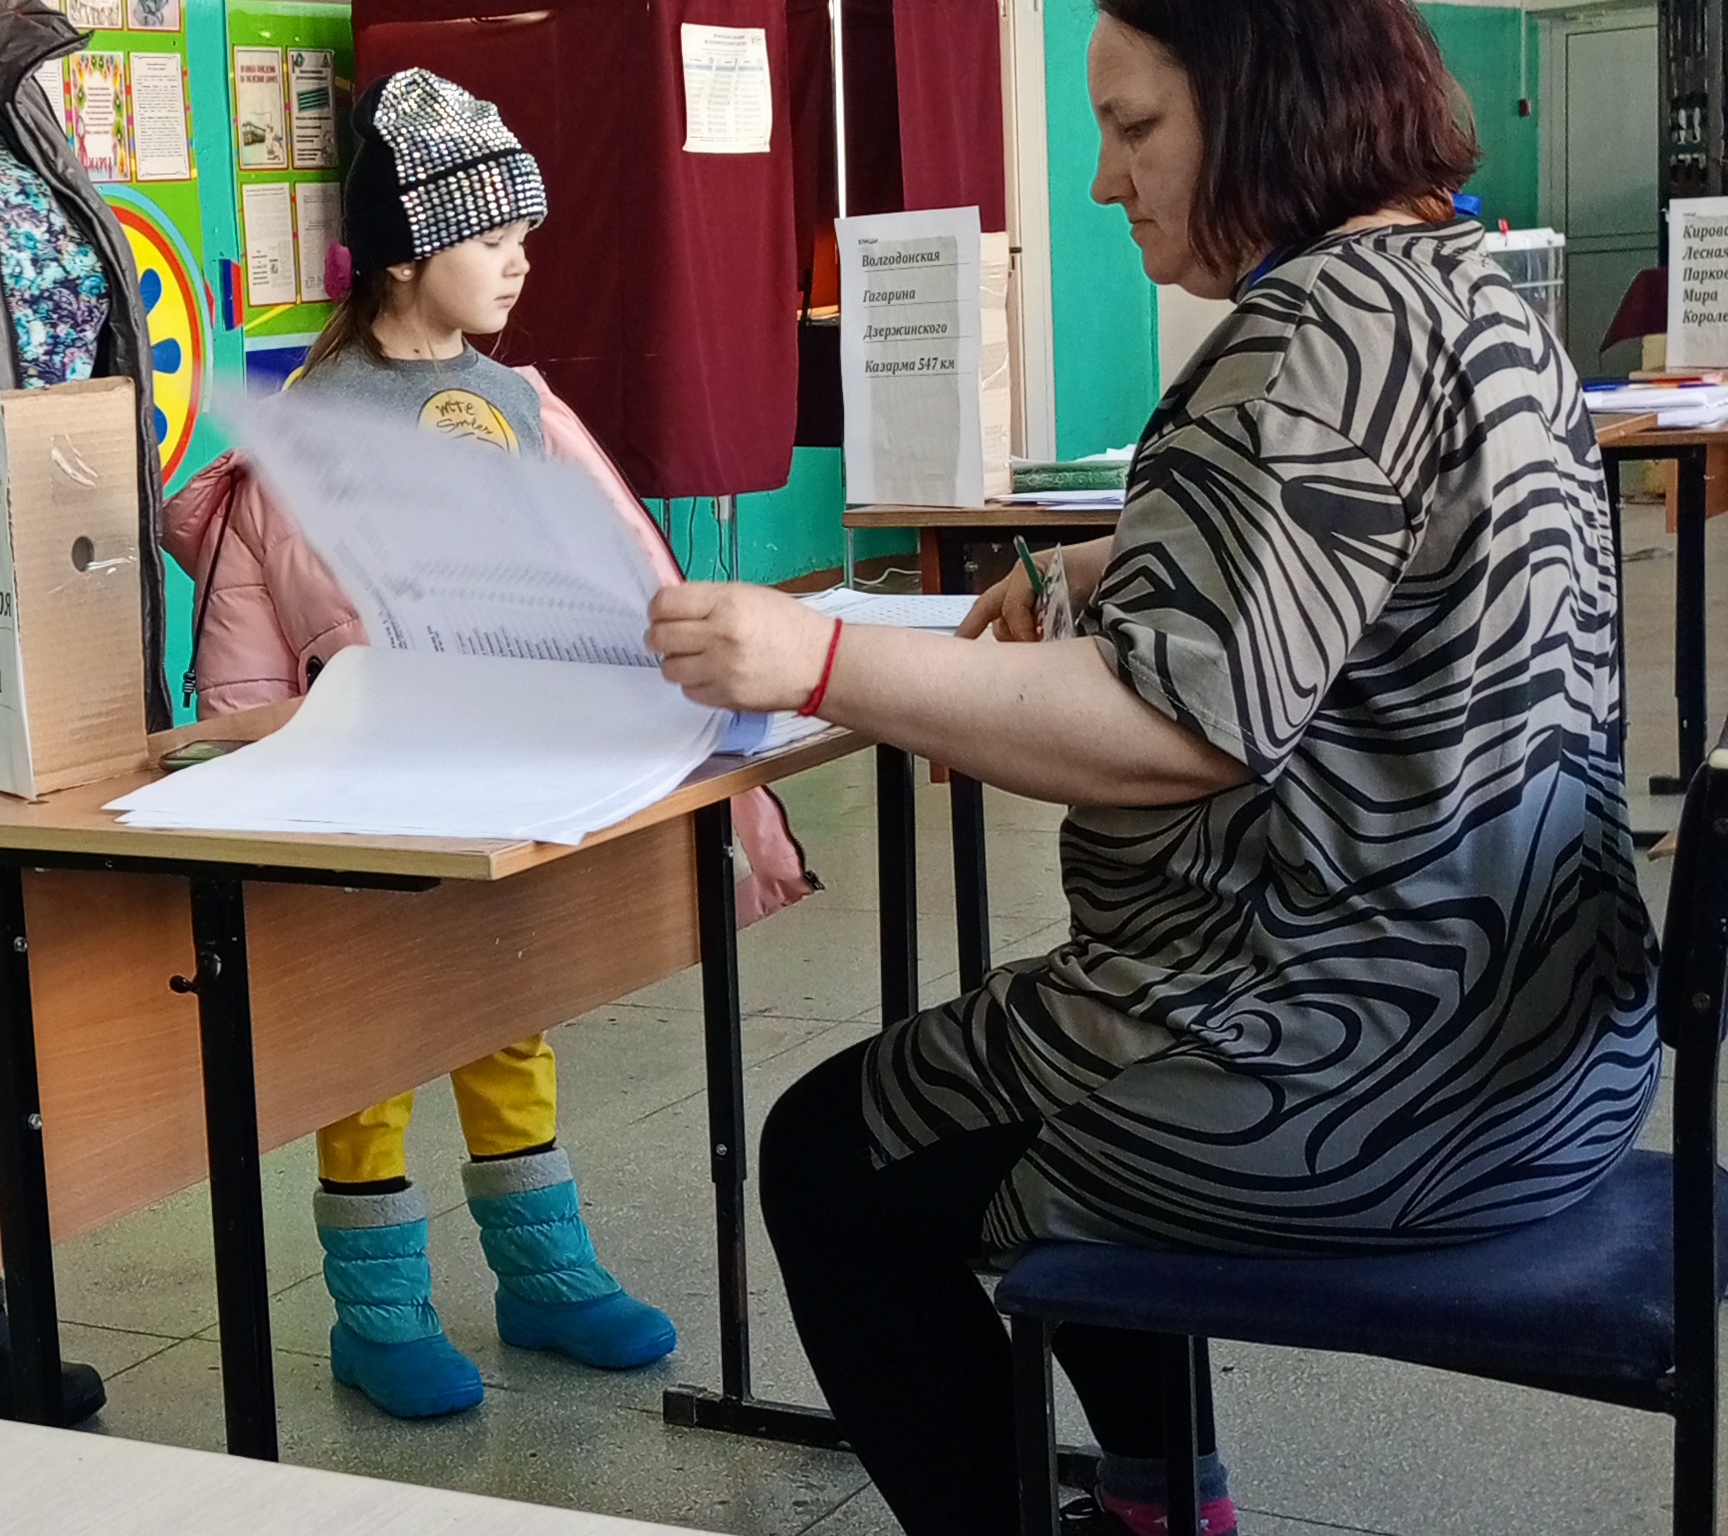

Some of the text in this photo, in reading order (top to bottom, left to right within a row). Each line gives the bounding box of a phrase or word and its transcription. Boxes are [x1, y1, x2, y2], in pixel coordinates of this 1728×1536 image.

[861, 249, 941, 268] Волгодонская
[862, 287, 917, 305] Гагарина
[1682, 287, 1719, 306] Мира
[863, 322, 948, 342] Дзержинского
[864, 357, 955, 375] Казарма 547 км
